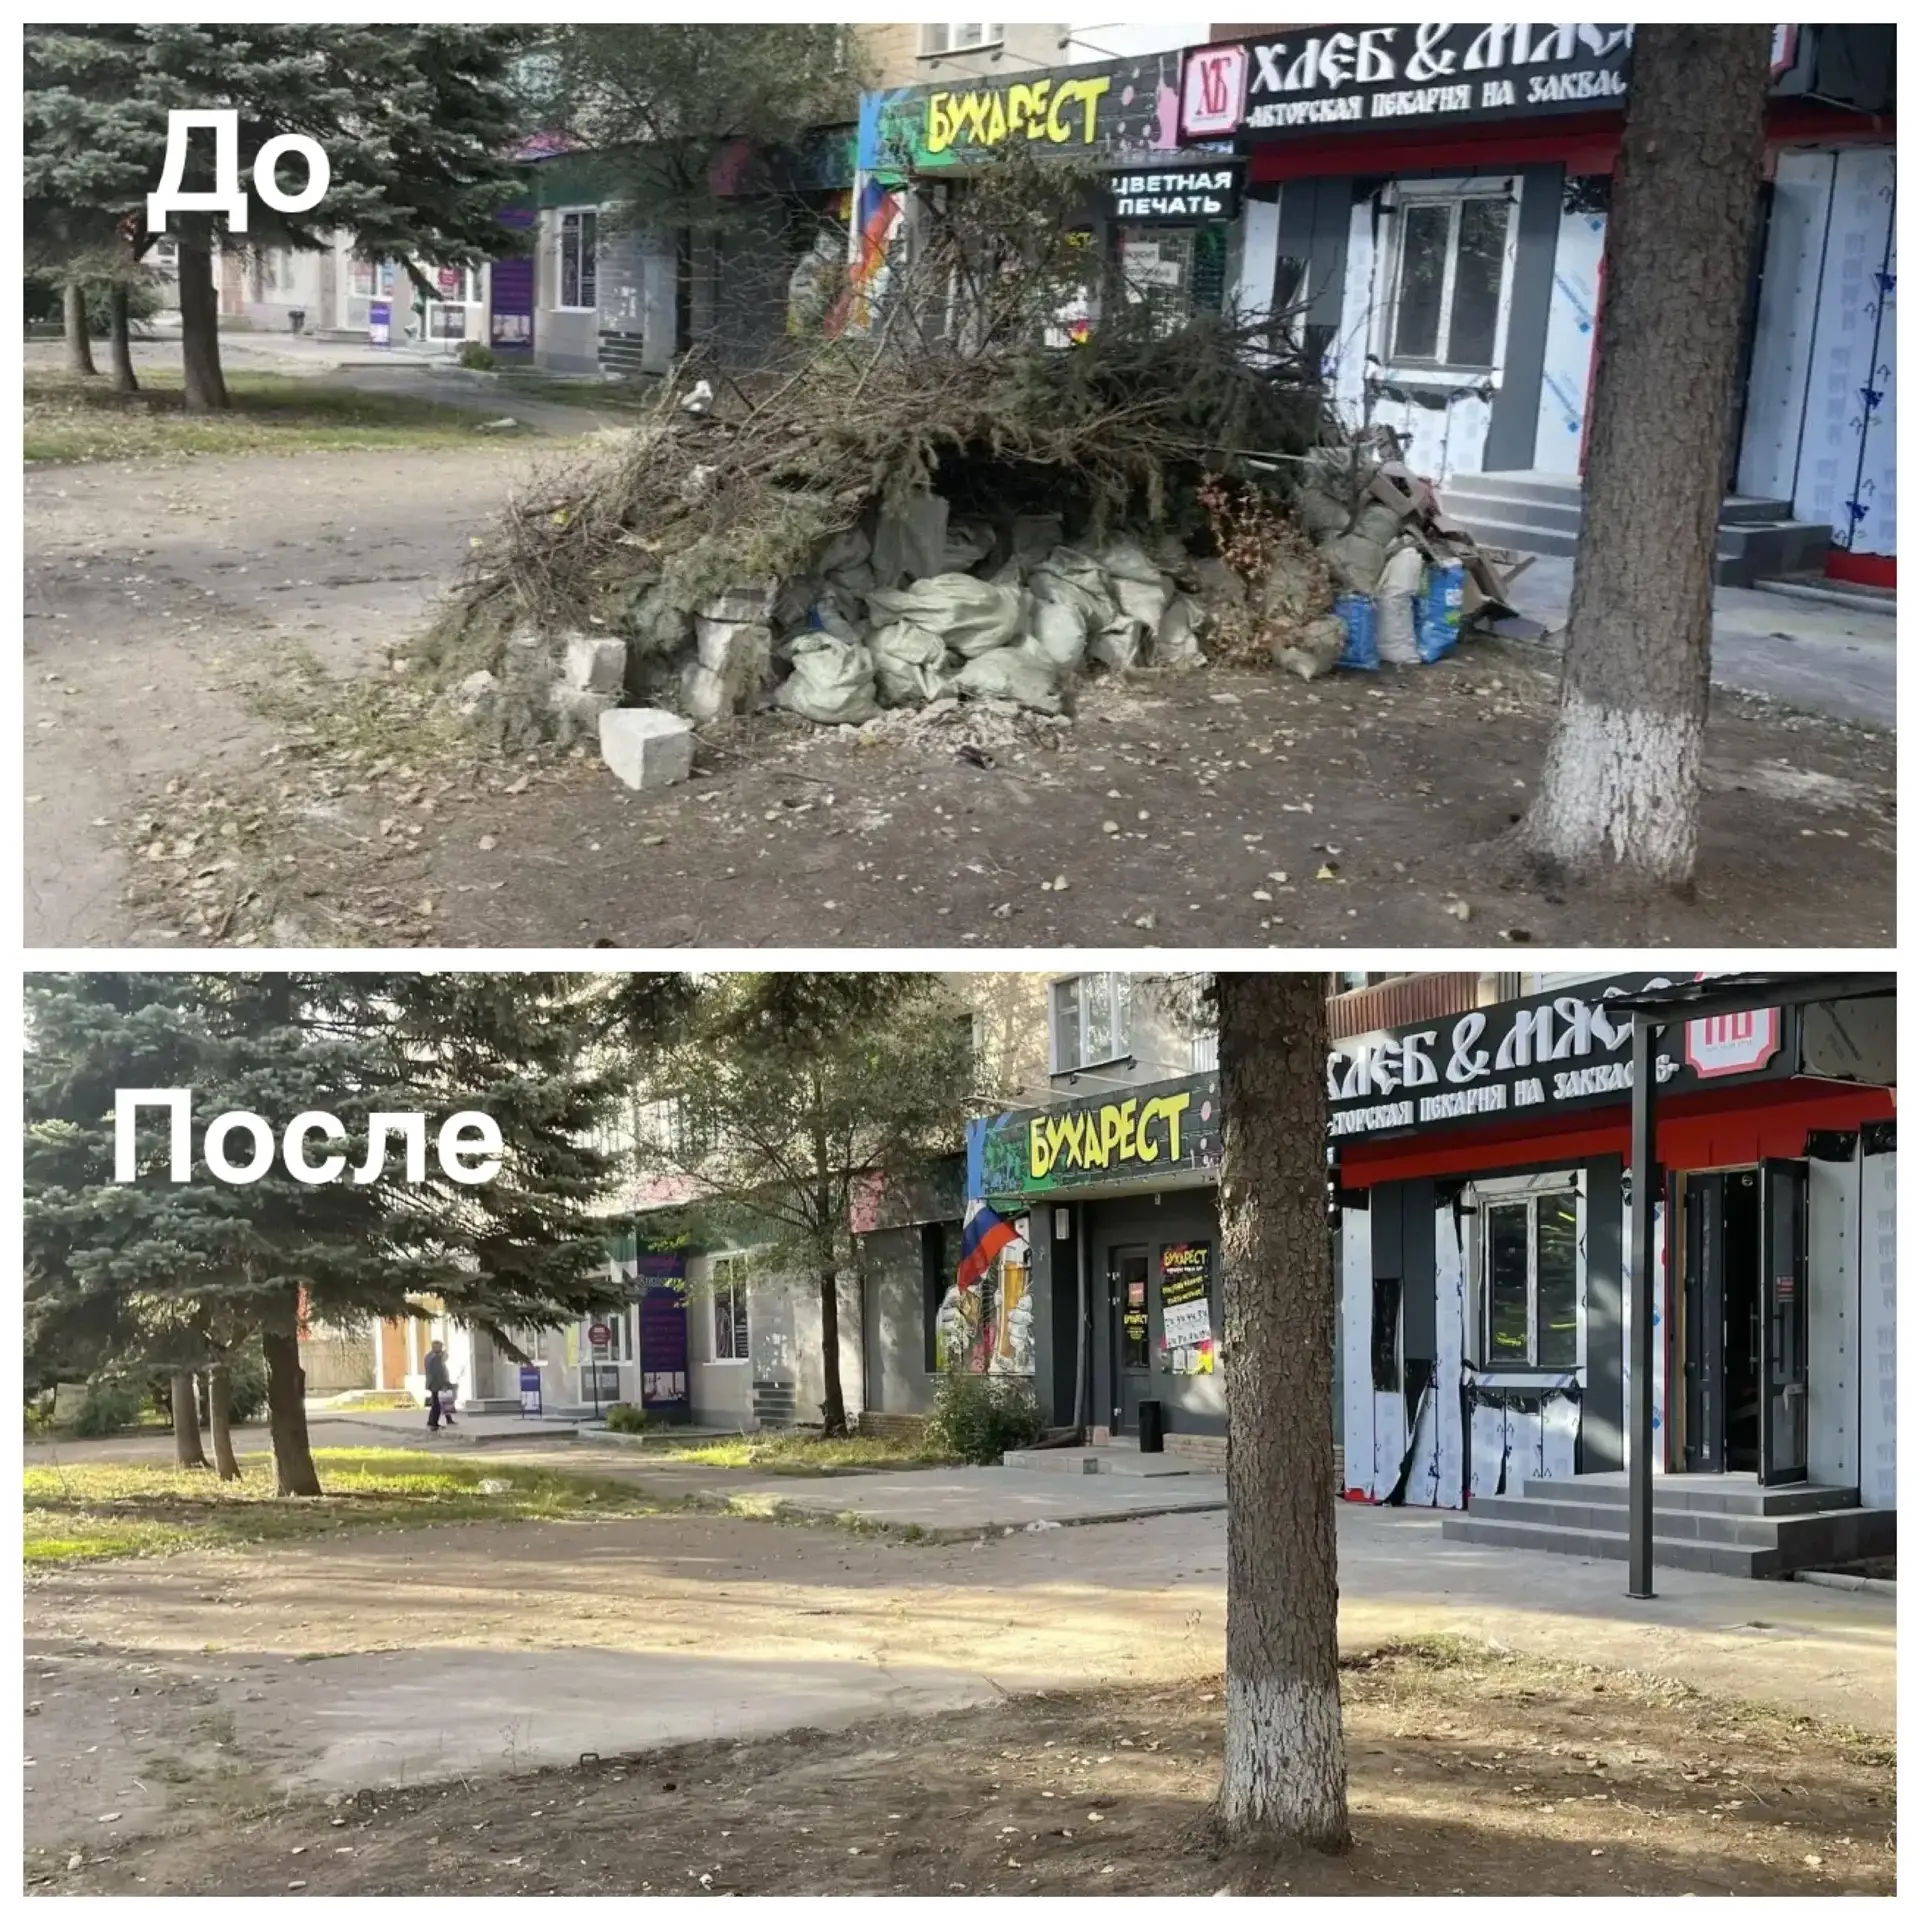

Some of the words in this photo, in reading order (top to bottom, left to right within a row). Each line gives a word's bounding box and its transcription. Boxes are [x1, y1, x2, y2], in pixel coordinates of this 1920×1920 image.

[1250, 28, 1397, 93] ХЛЕБ
[1405, 24, 1456, 82] &
[1463, 23, 1636, 71] МЯС
[928, 76, 1111, 153] БУХАРЕСТ
[1371, 83, 1472, 119] ПЕКАРНЯ
[1482, 80, 1516, 108] НА
[1527, 69, 1628, 104] ЗАКВАС
[1111, 171, 1233, 196] ЦВЕТНАЯ
[1117, 195, 1222, 216] ПЕЧАТЬ
[1446, 1013, 1491, 1084] &
[1420, 1083, 1507, 1122] ПЕКАРНЯ
[1514, 1077, 1545, 1107] НА
[1030, 1092, 1190, 1178] БУХАРЕСТ
